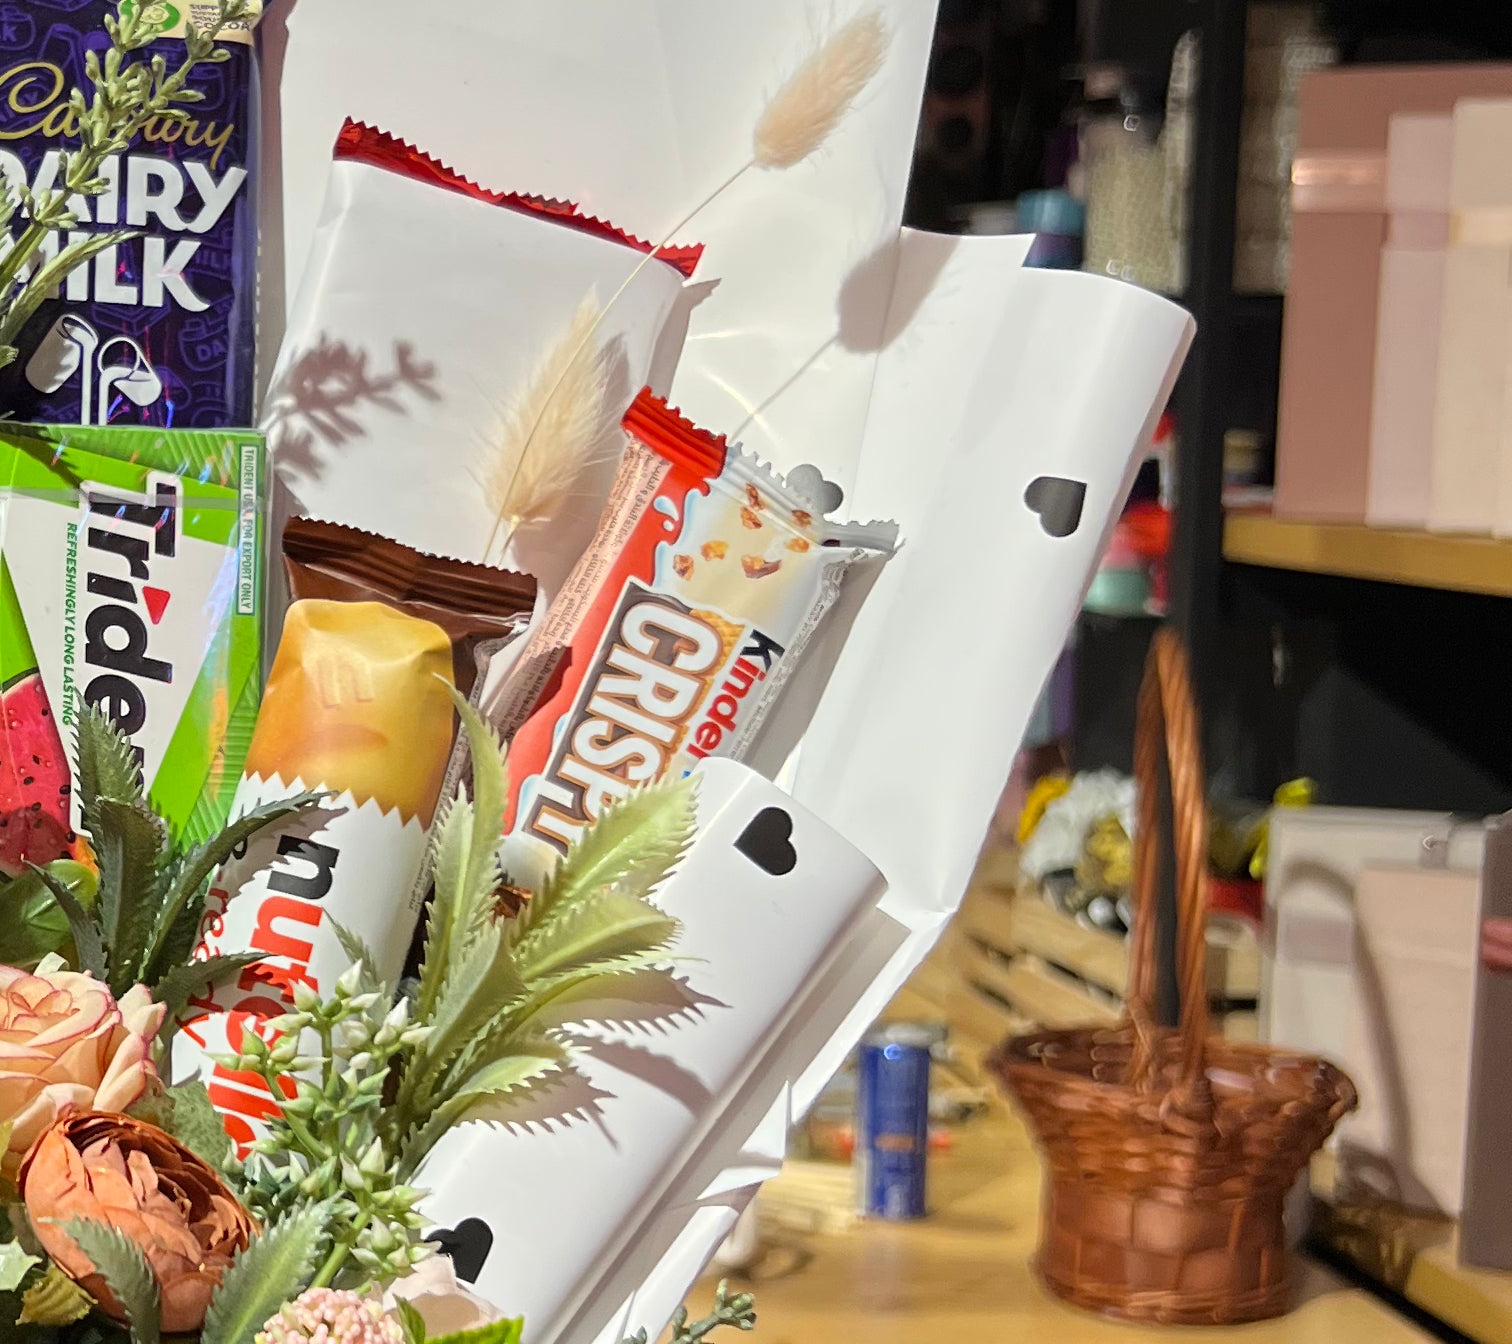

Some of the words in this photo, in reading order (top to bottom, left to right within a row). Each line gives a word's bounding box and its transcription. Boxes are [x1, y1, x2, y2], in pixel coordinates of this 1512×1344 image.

[243, 449, 255, 493] TRIDENT
[64, 522, 78, 623] REFRESHINGLY
[240, 539, 253, 580] EXPORT
[240, 581, 252, 610] ONLY
[63, 625, 76, 665] LONG
[83, 481, 177, 791] Tride
[62, 666, 75, 726] LASTING
